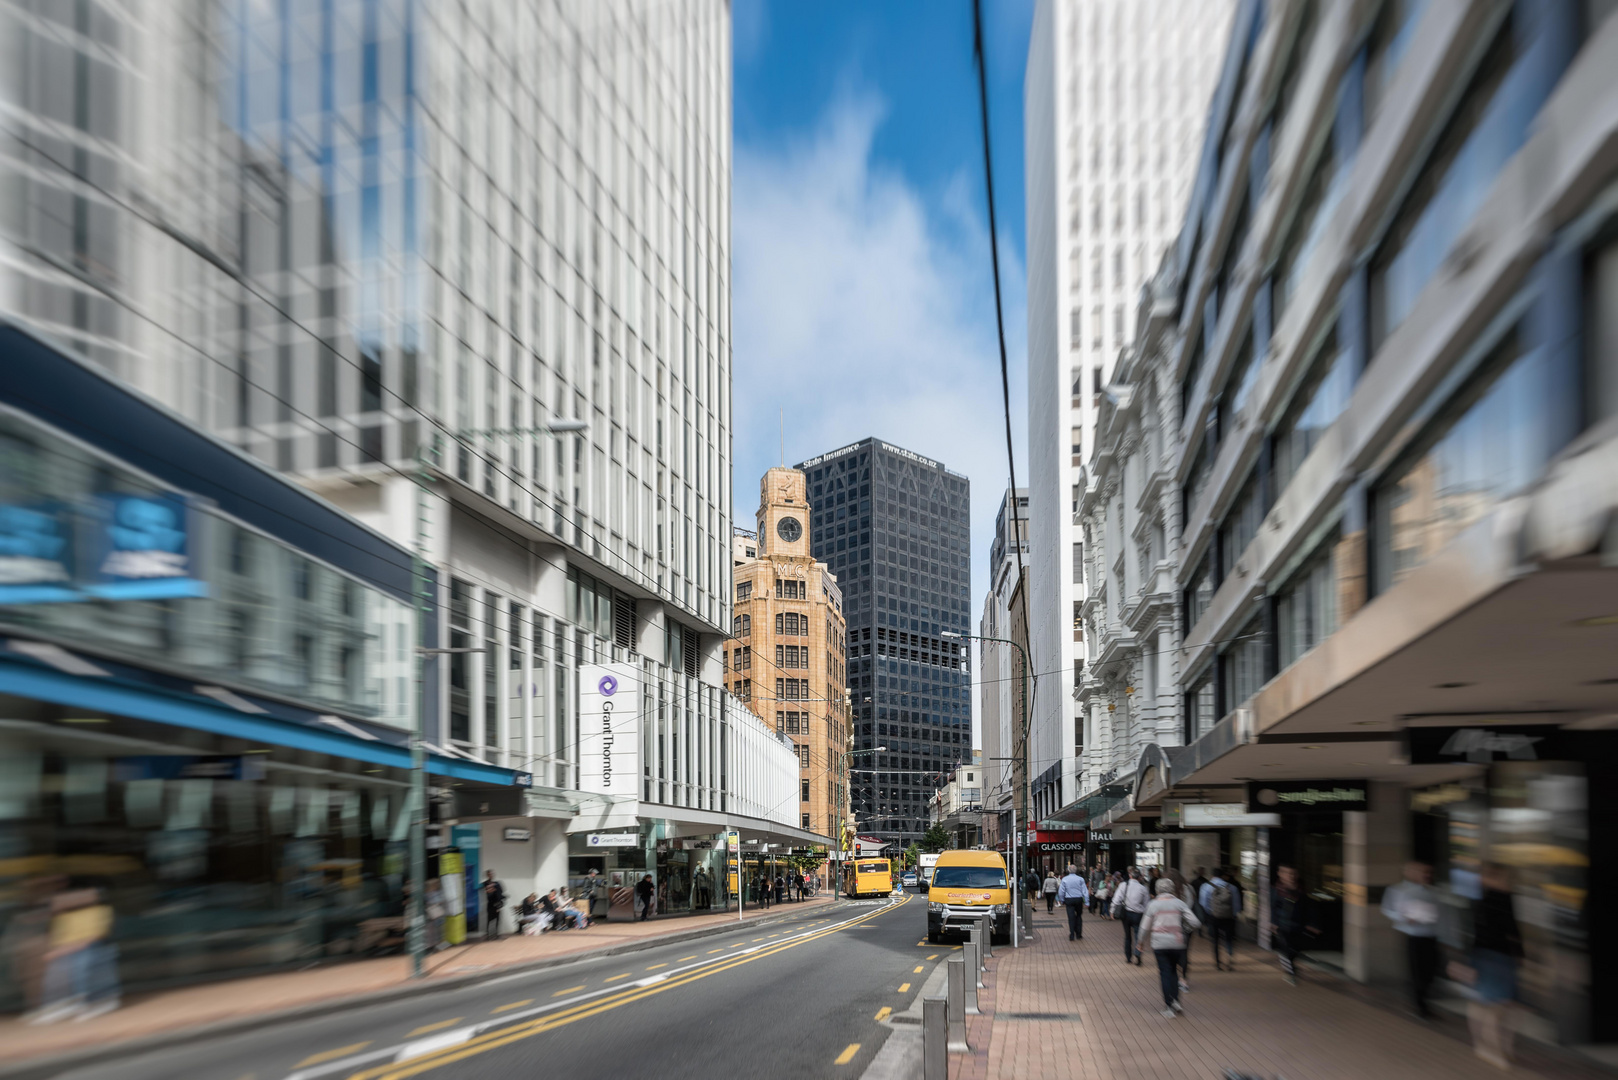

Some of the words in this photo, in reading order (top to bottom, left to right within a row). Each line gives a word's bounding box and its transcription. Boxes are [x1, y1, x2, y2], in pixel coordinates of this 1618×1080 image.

[803, 457, 822, 469] State
[823, 443, 860, 462] Insurance
[881, 442, 937, 469] www.state.co.nz
[602, 701, 614, 734] Grant
[603, 734, 614, 787] Thornton
[1041, 843, 1082, 851] GLASSONS
